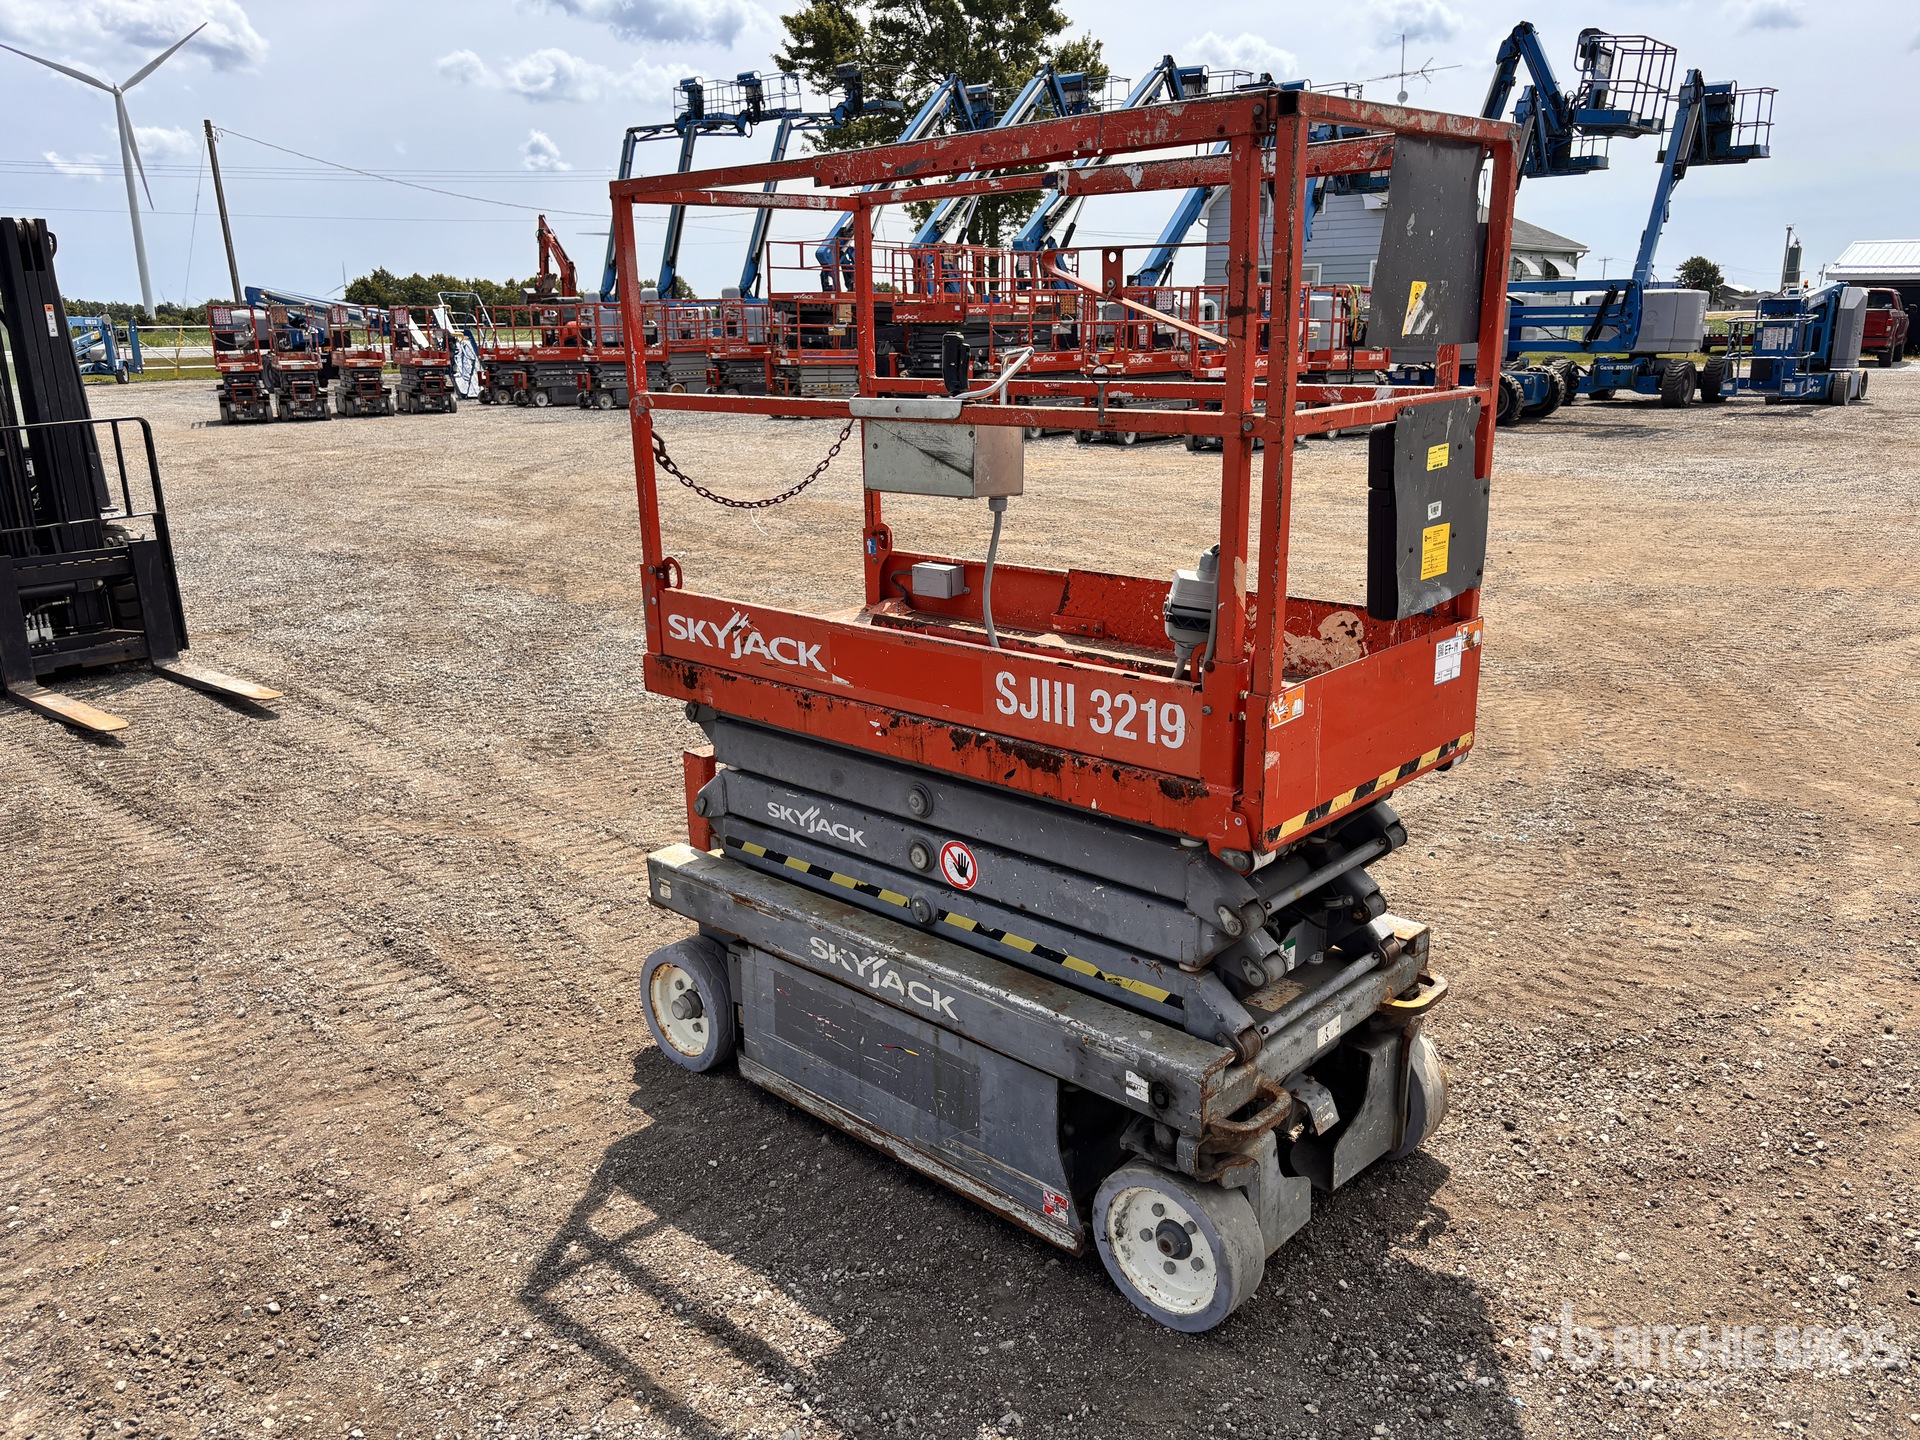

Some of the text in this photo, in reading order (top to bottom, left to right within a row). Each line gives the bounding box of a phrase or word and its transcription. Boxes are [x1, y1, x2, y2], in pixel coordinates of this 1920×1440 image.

[1033, 354, 1057, 363] SKYJACK
[1129, 354, 1153, 364] SKYJACK
[667, 607, 828, 672] SKYJACK
[996, 671, 1186, 749] SJIII 3219
[767, 801, 867, 848] SKYJACK
[809, 936, 959, 1021] SKYJACK
